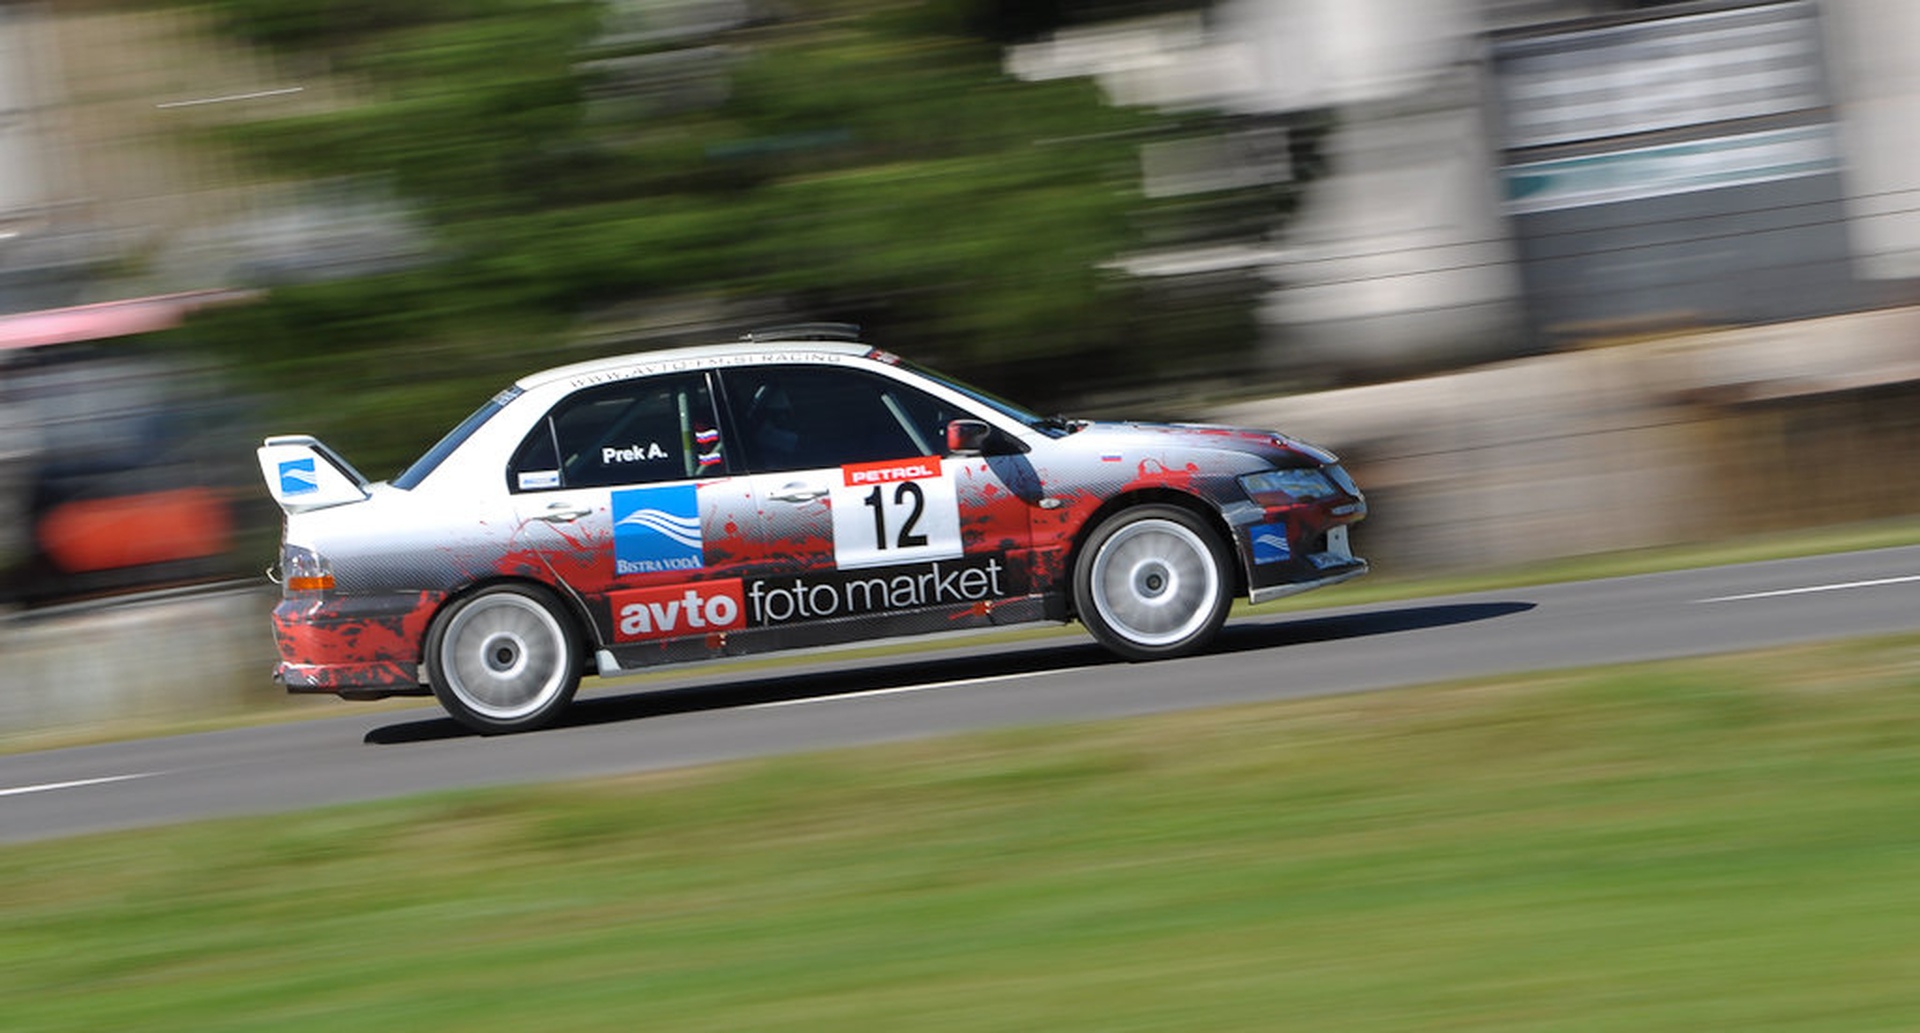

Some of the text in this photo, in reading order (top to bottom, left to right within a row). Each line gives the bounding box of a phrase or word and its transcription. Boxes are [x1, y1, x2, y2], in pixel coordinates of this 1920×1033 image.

[762, 352, 841, 363] RACING
[602, 443, 668, 463] Prek A.
[852, 465, 933, 482] PETROL
[864, 481, 928, 550] 12
[620, 590, 737, 635] avto
